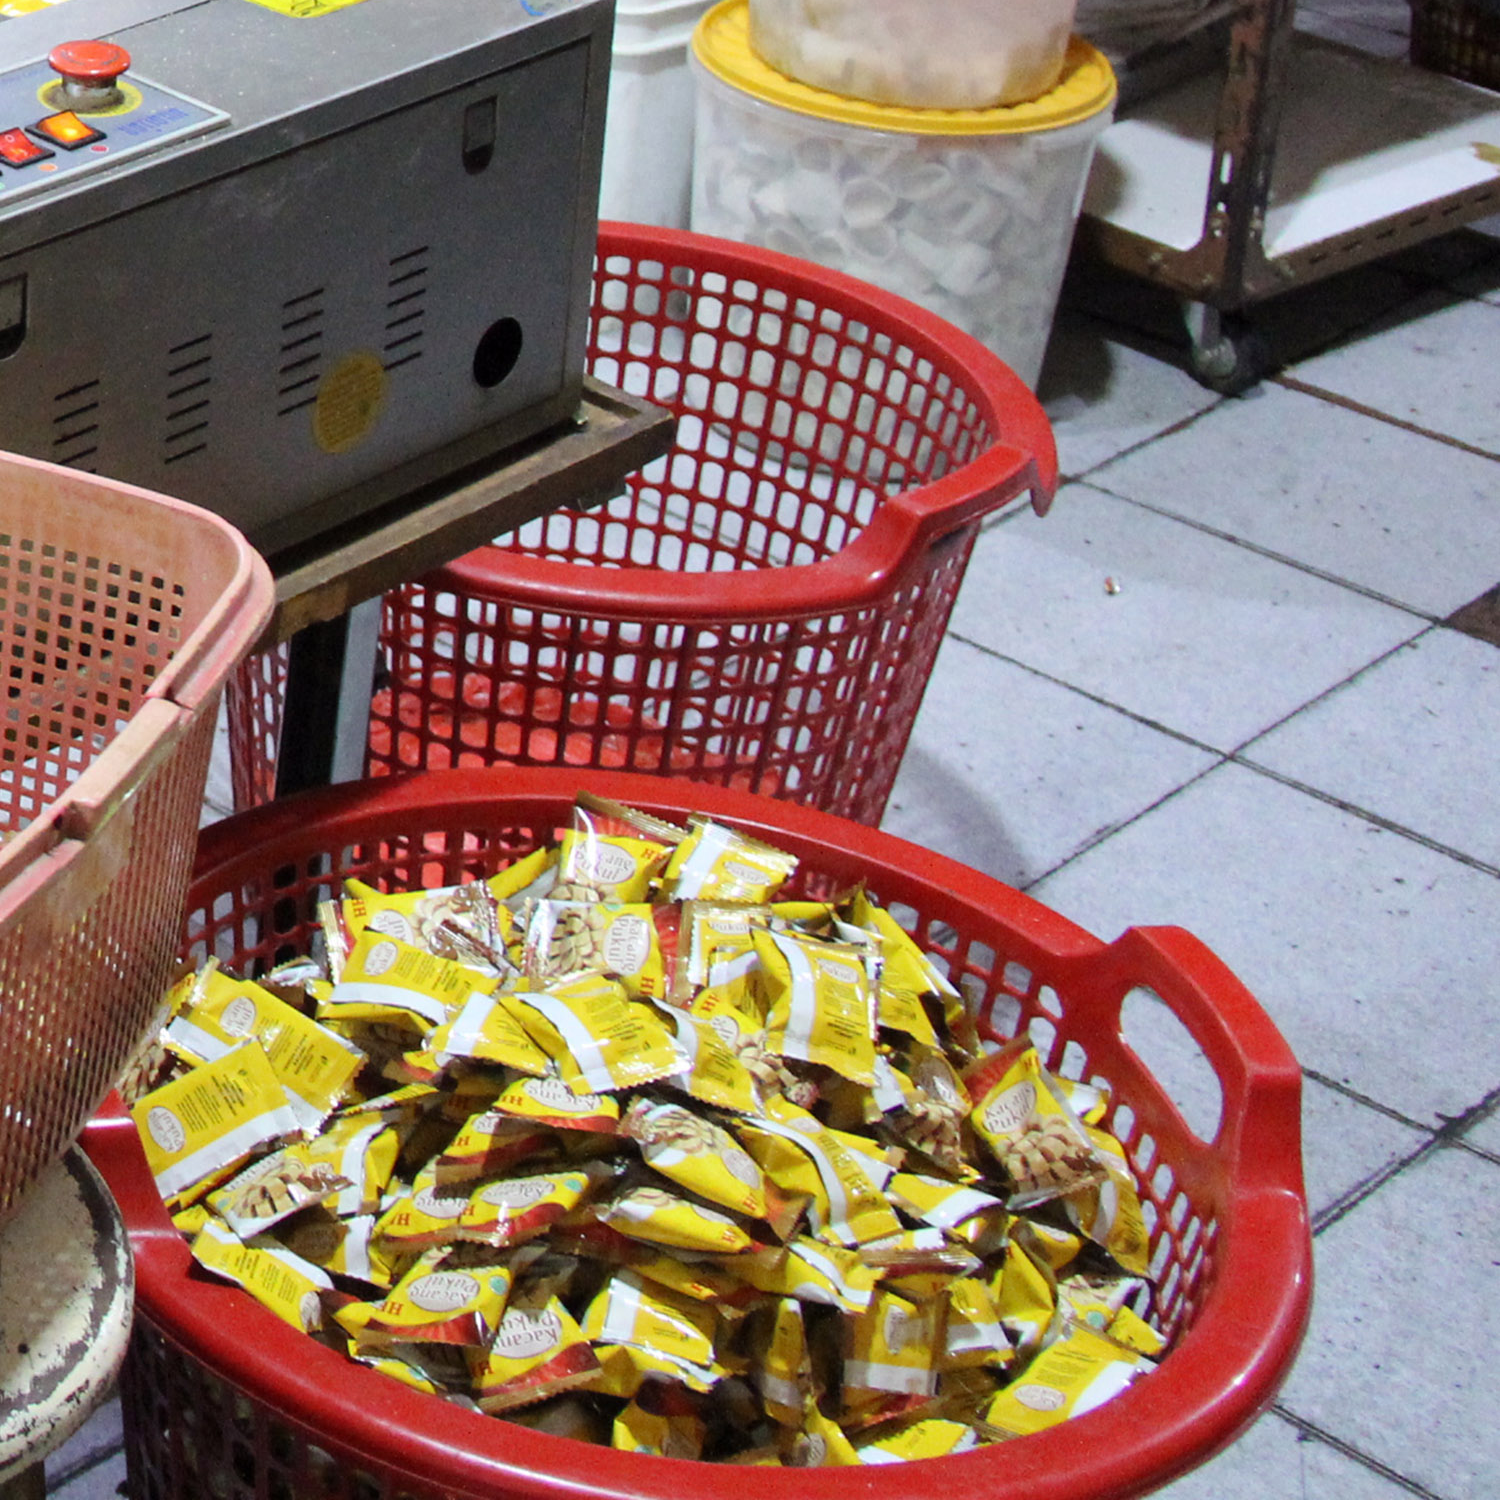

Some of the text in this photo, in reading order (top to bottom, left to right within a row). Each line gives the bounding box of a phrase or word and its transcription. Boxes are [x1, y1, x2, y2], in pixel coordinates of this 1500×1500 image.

[608, 917, 630, 963] Pukul
[423, 1274, 479, 1293] Pukul
[410, 1286, 468, 1307] Kacang
[494, 1328, 559, 1350] Kacan
